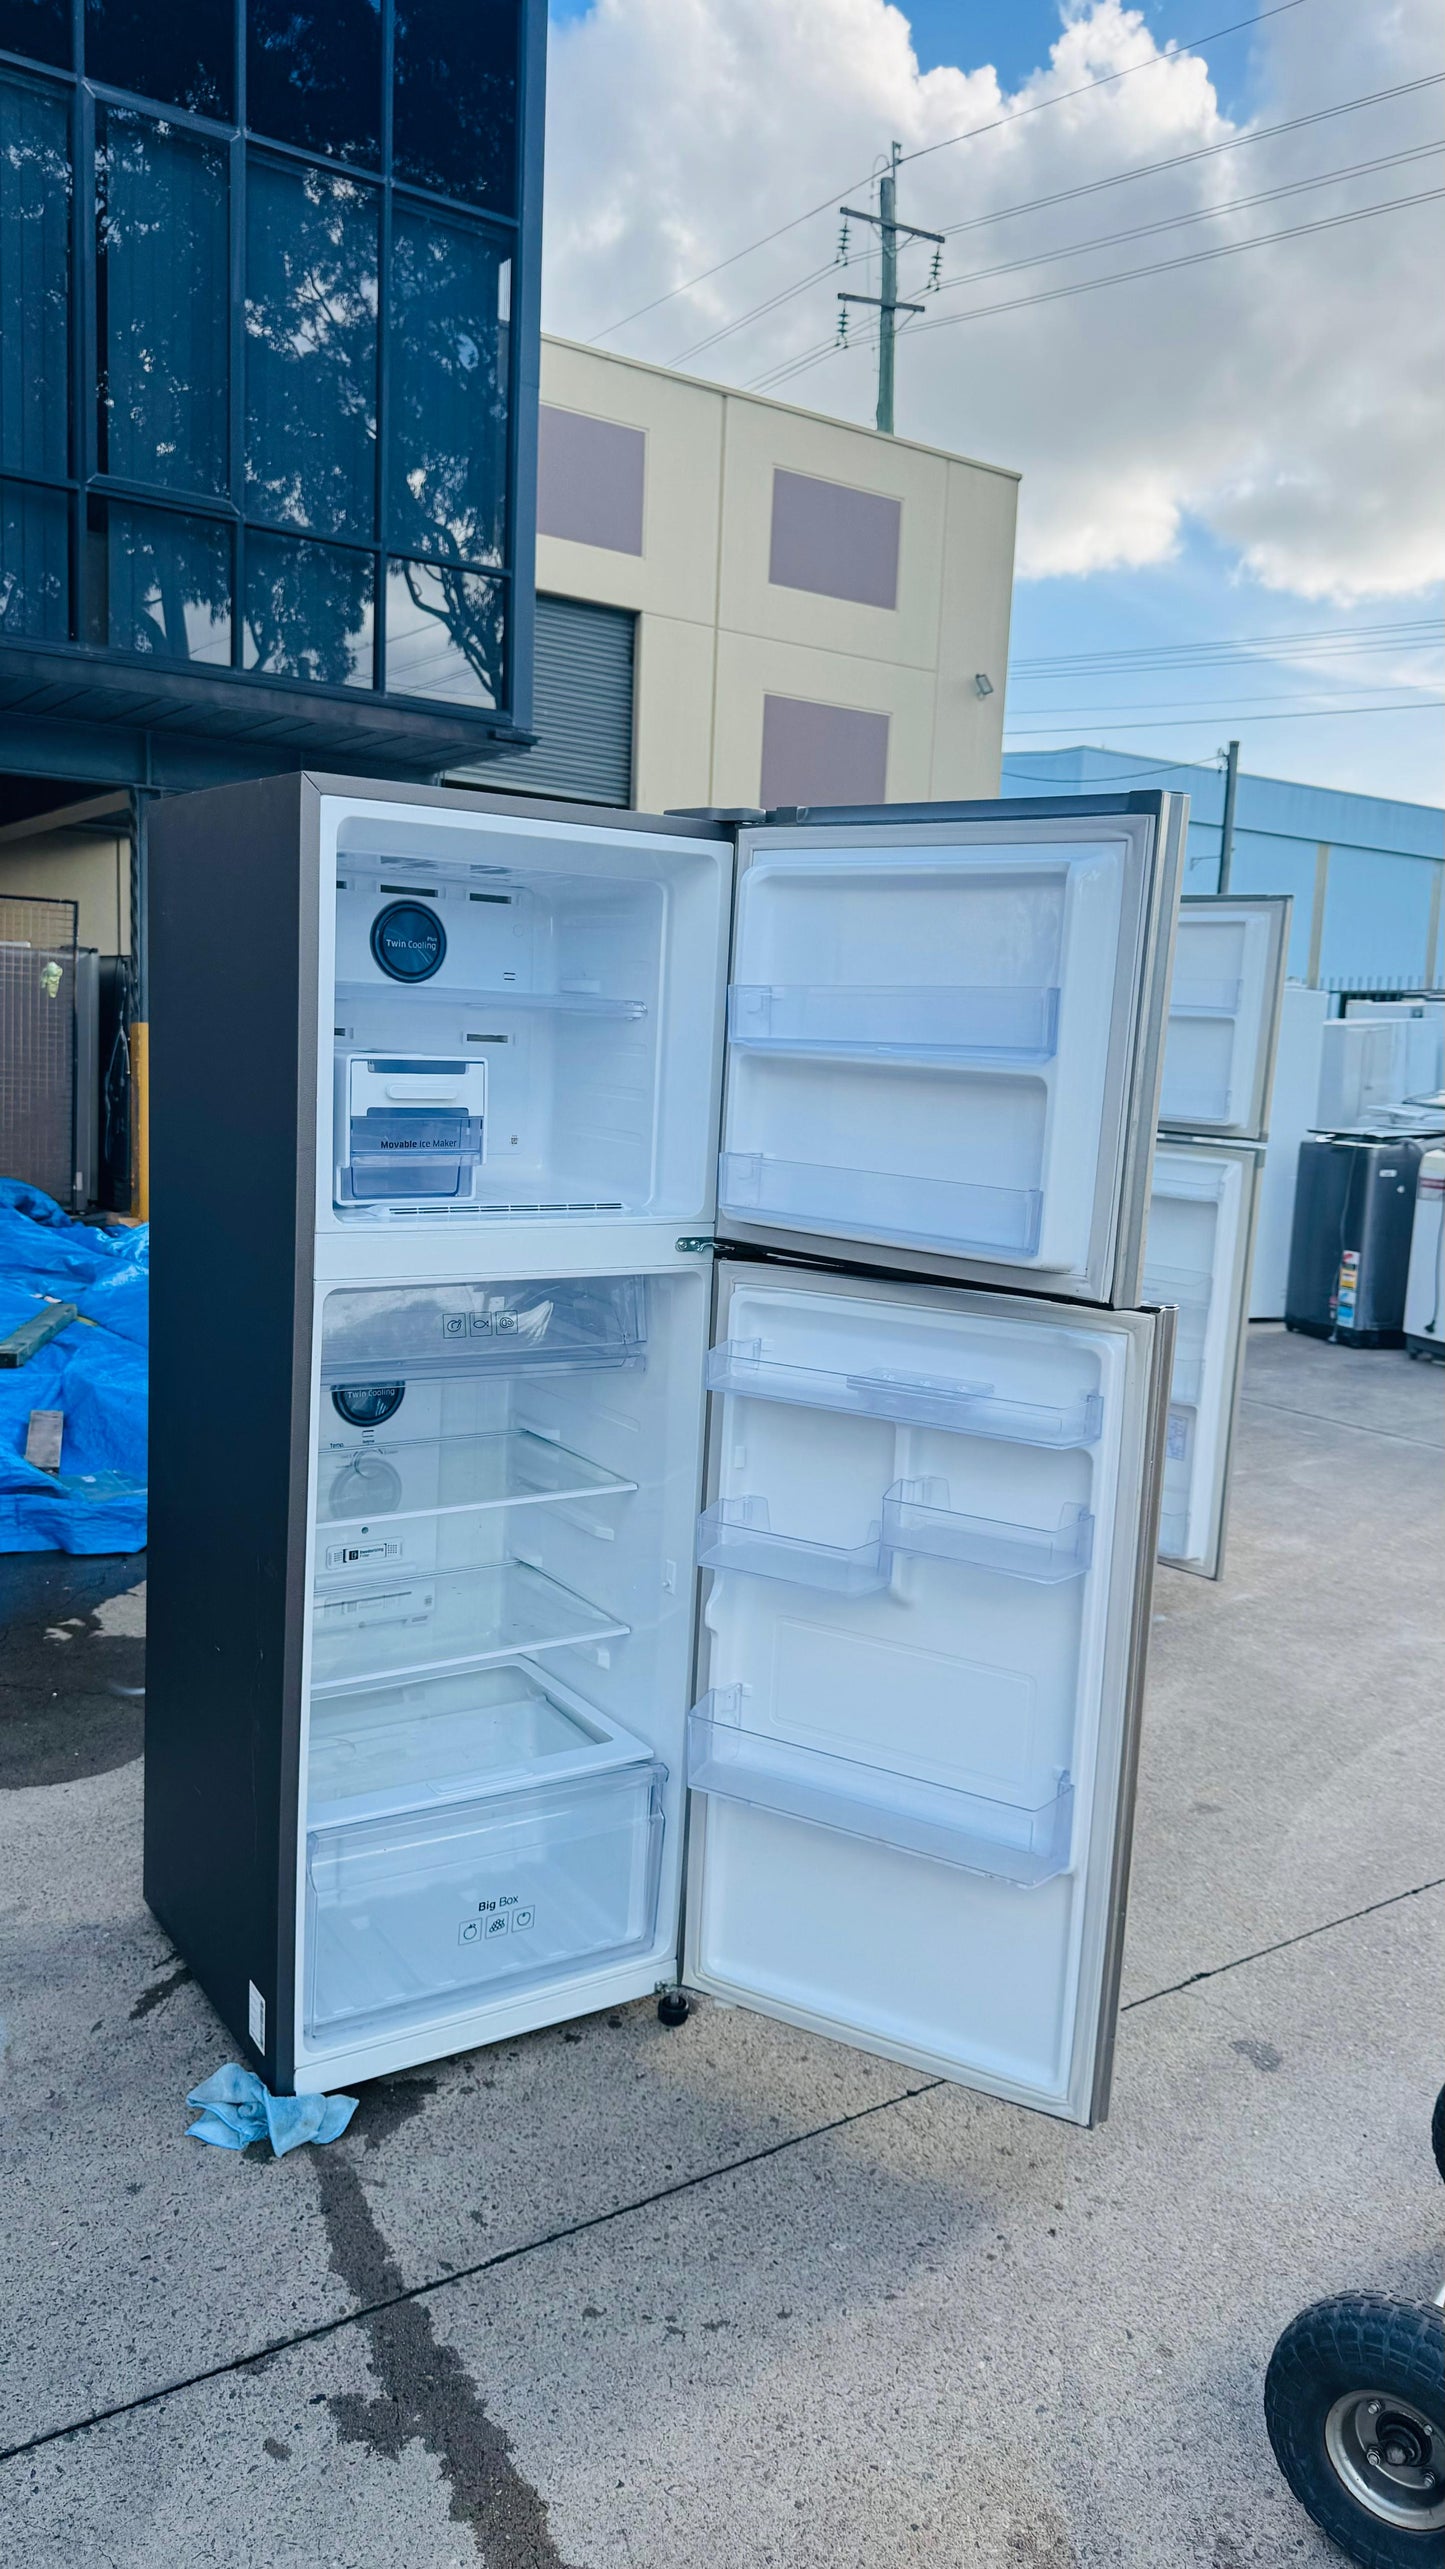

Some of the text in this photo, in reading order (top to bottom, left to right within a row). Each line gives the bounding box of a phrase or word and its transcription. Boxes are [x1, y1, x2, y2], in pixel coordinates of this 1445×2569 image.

[386, 938, 437, 952] Twin Cooling
[380, 1139, 457, 1149] Movable Ice Maker
[347, 1388, 396, 1399] Twin Cooling
[478, 1895, 519, 1912] Big Box
